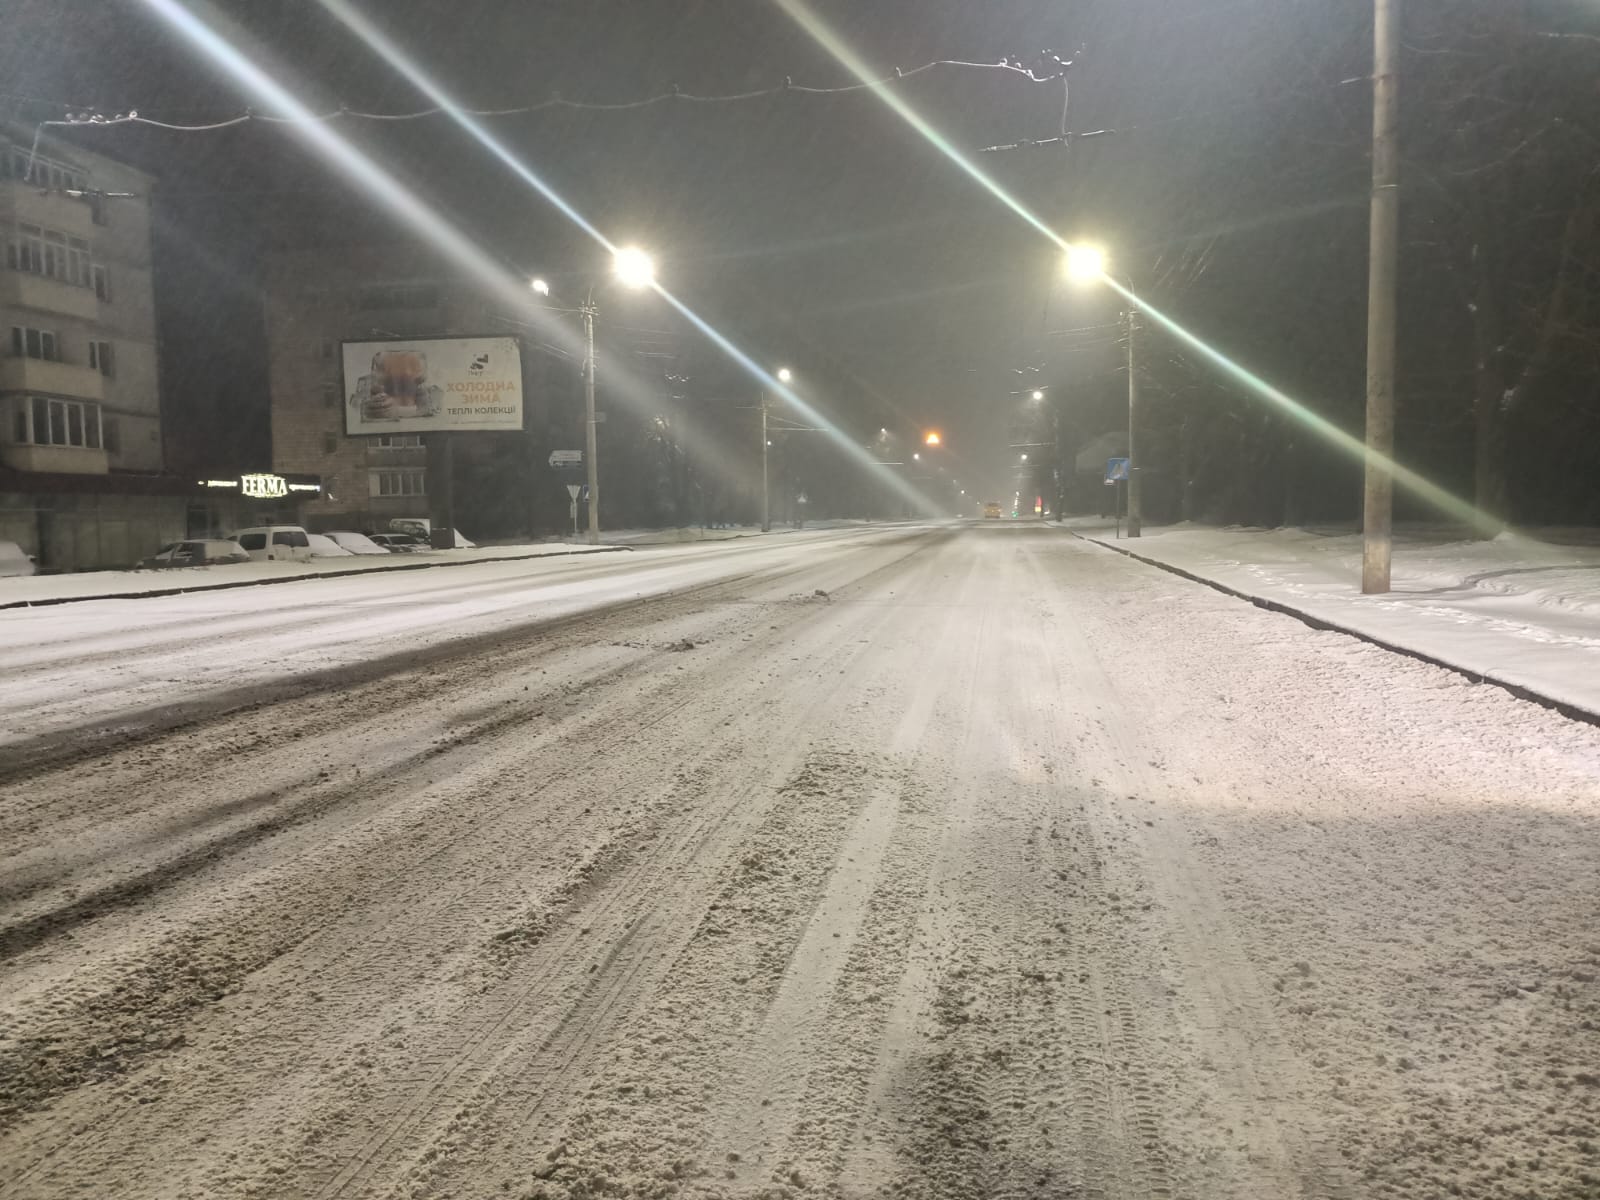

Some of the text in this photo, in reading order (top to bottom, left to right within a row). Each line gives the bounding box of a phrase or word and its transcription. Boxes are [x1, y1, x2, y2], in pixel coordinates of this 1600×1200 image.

[447, 381, 515, 392] ХОЛОДНА
[462, 393, 501, 404] ЗИМА
[447, 407, 472, 415] ТЕПЛІ
[241, 475, 288, 495] FERMA
